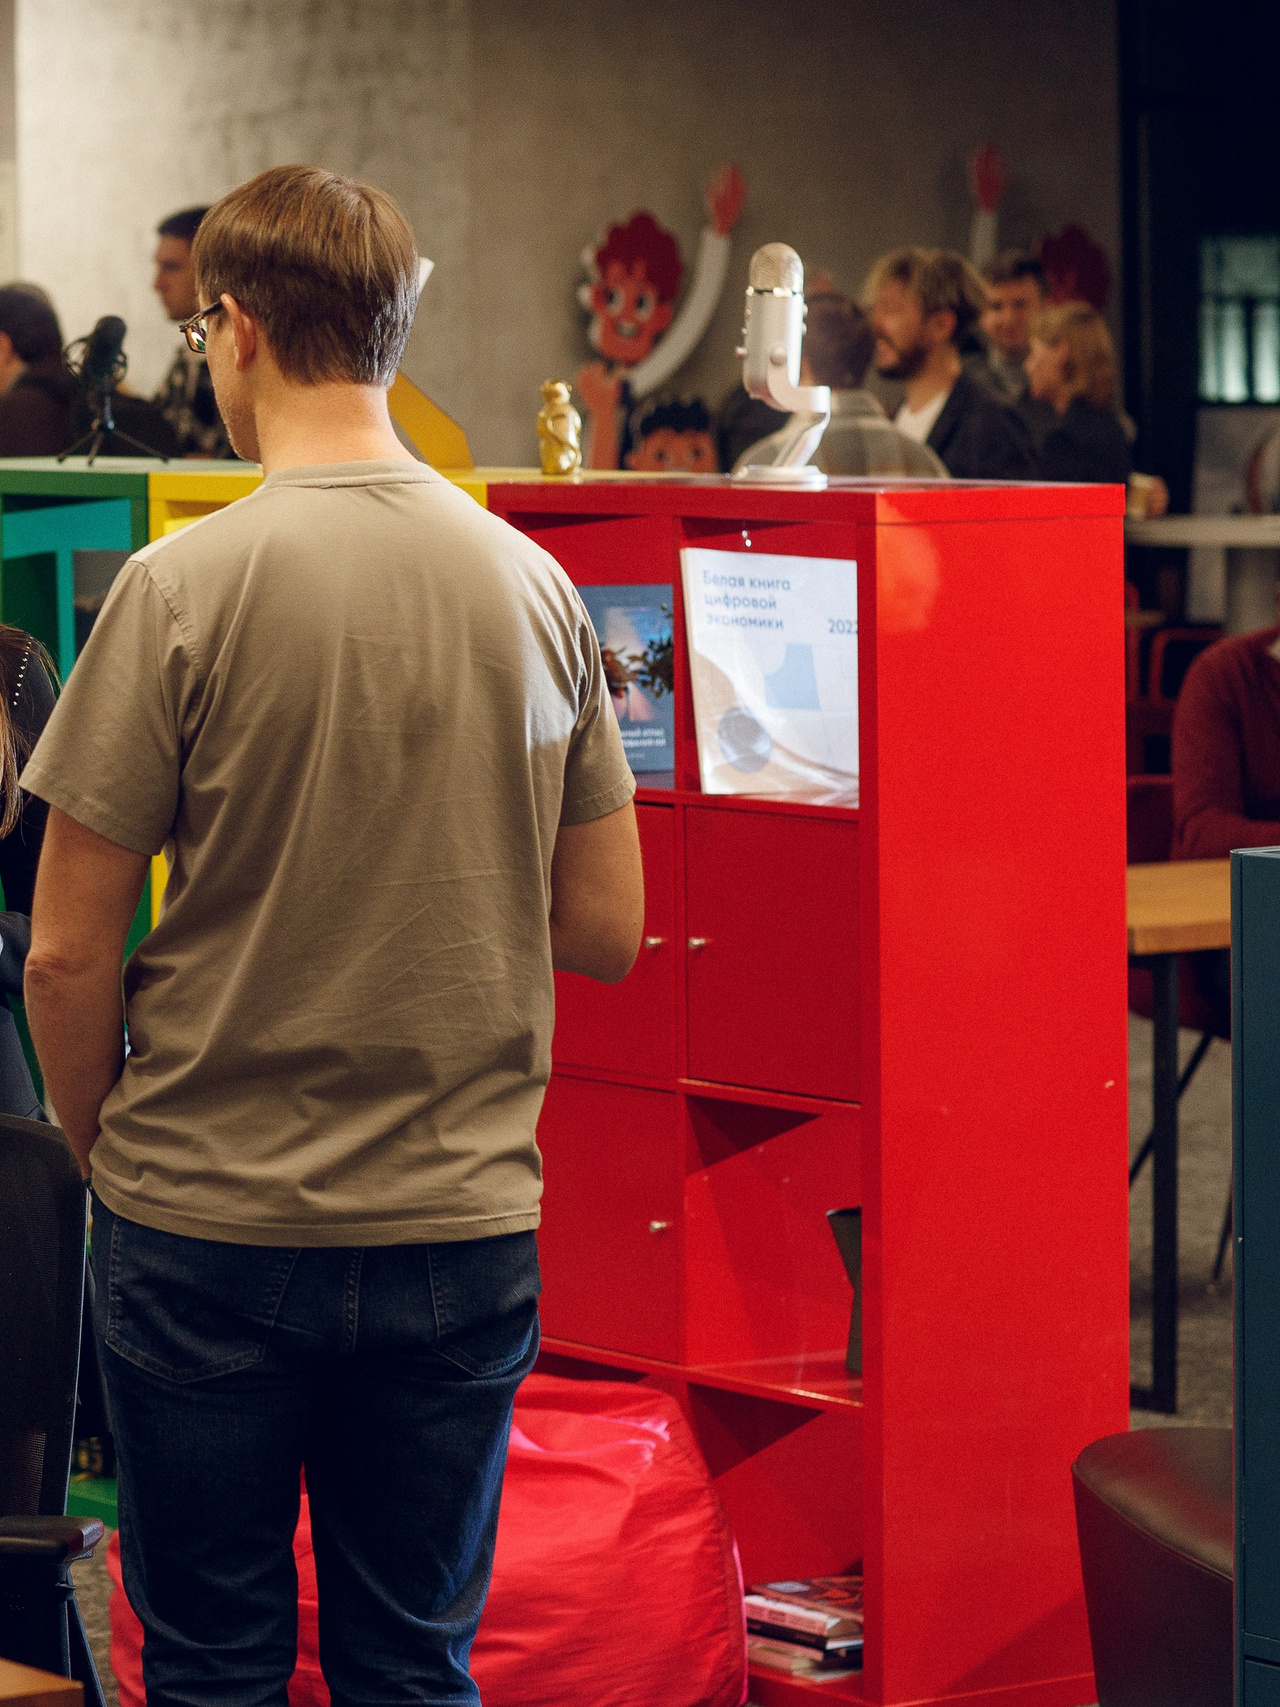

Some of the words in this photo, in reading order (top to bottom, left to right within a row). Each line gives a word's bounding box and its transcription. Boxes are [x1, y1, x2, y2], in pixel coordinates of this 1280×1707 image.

[750, 579, 791, 591] книга
[705, 593, 777, 610] цифровой
[707, 614, 784, 629] экономики
